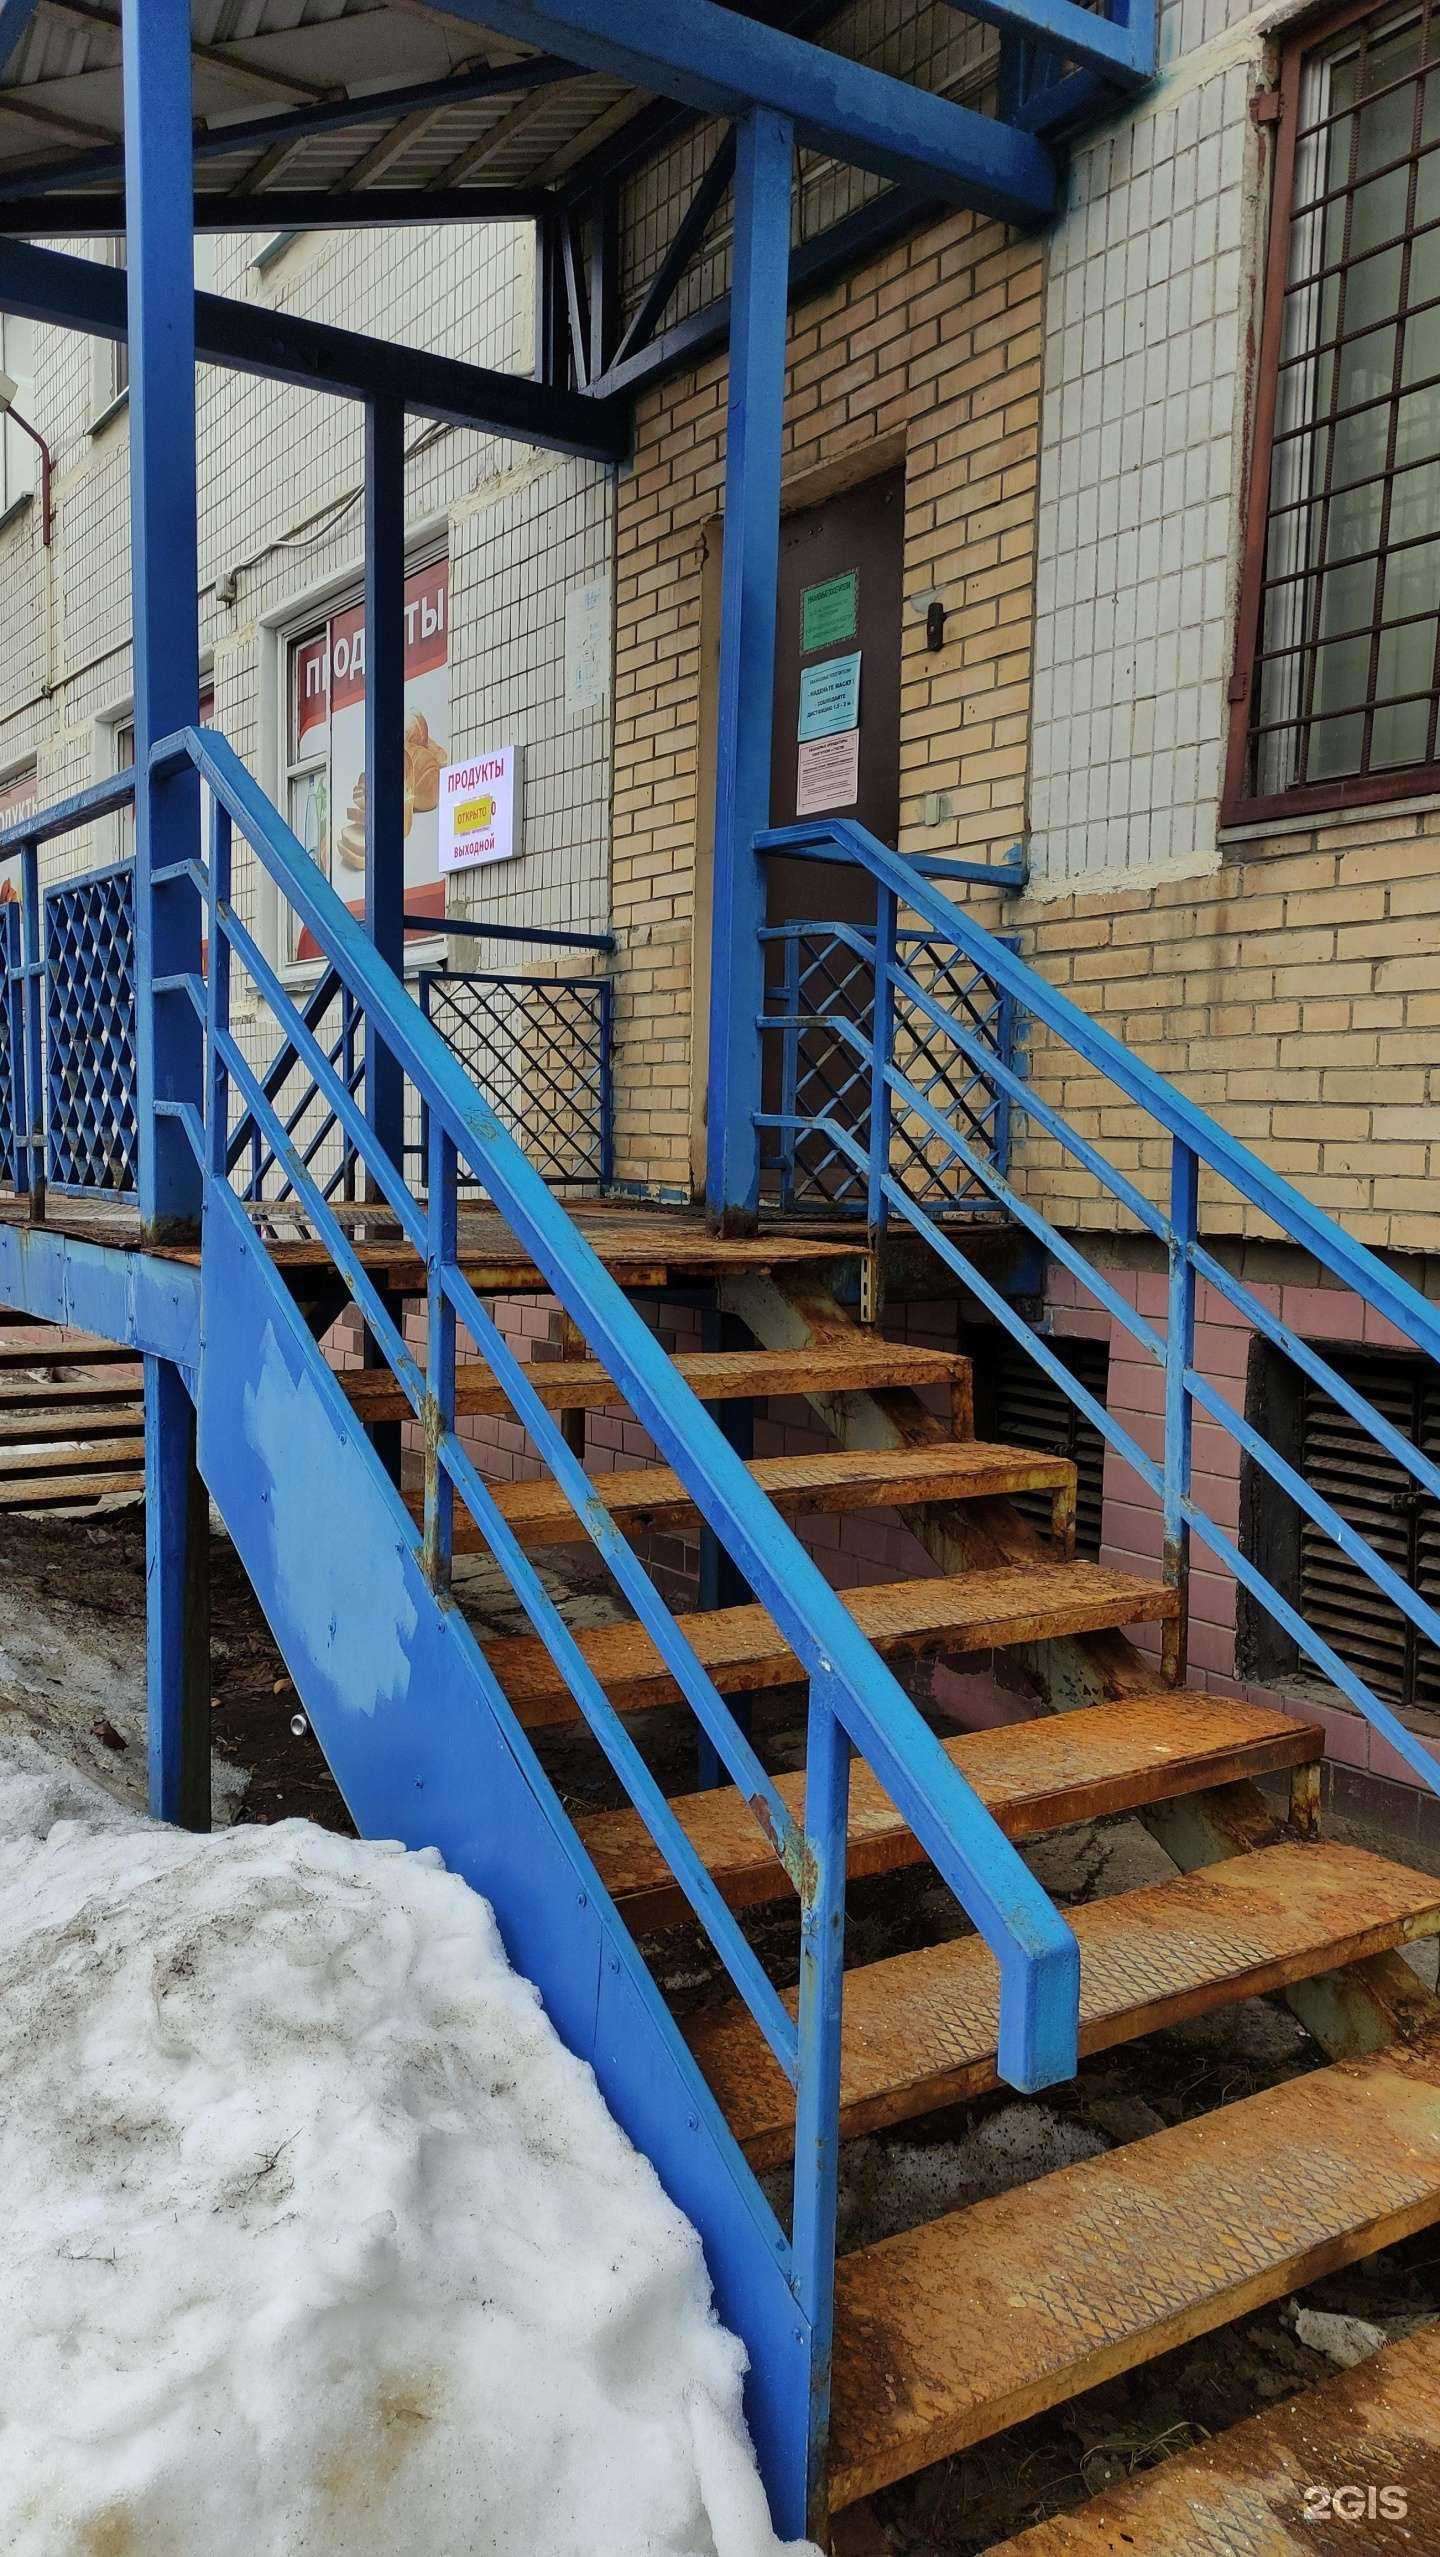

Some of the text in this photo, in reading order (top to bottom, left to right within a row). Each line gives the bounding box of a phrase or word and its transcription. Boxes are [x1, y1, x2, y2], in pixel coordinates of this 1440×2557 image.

[306, 588, 444, 698] ПОДТЫ
[448, 758, 504, 793] ПРОДУКТЫ
[457, 806, 487, 825] ОТКРЫТО
[454, 832, 495, 858] ВЫХОДНОЙ
